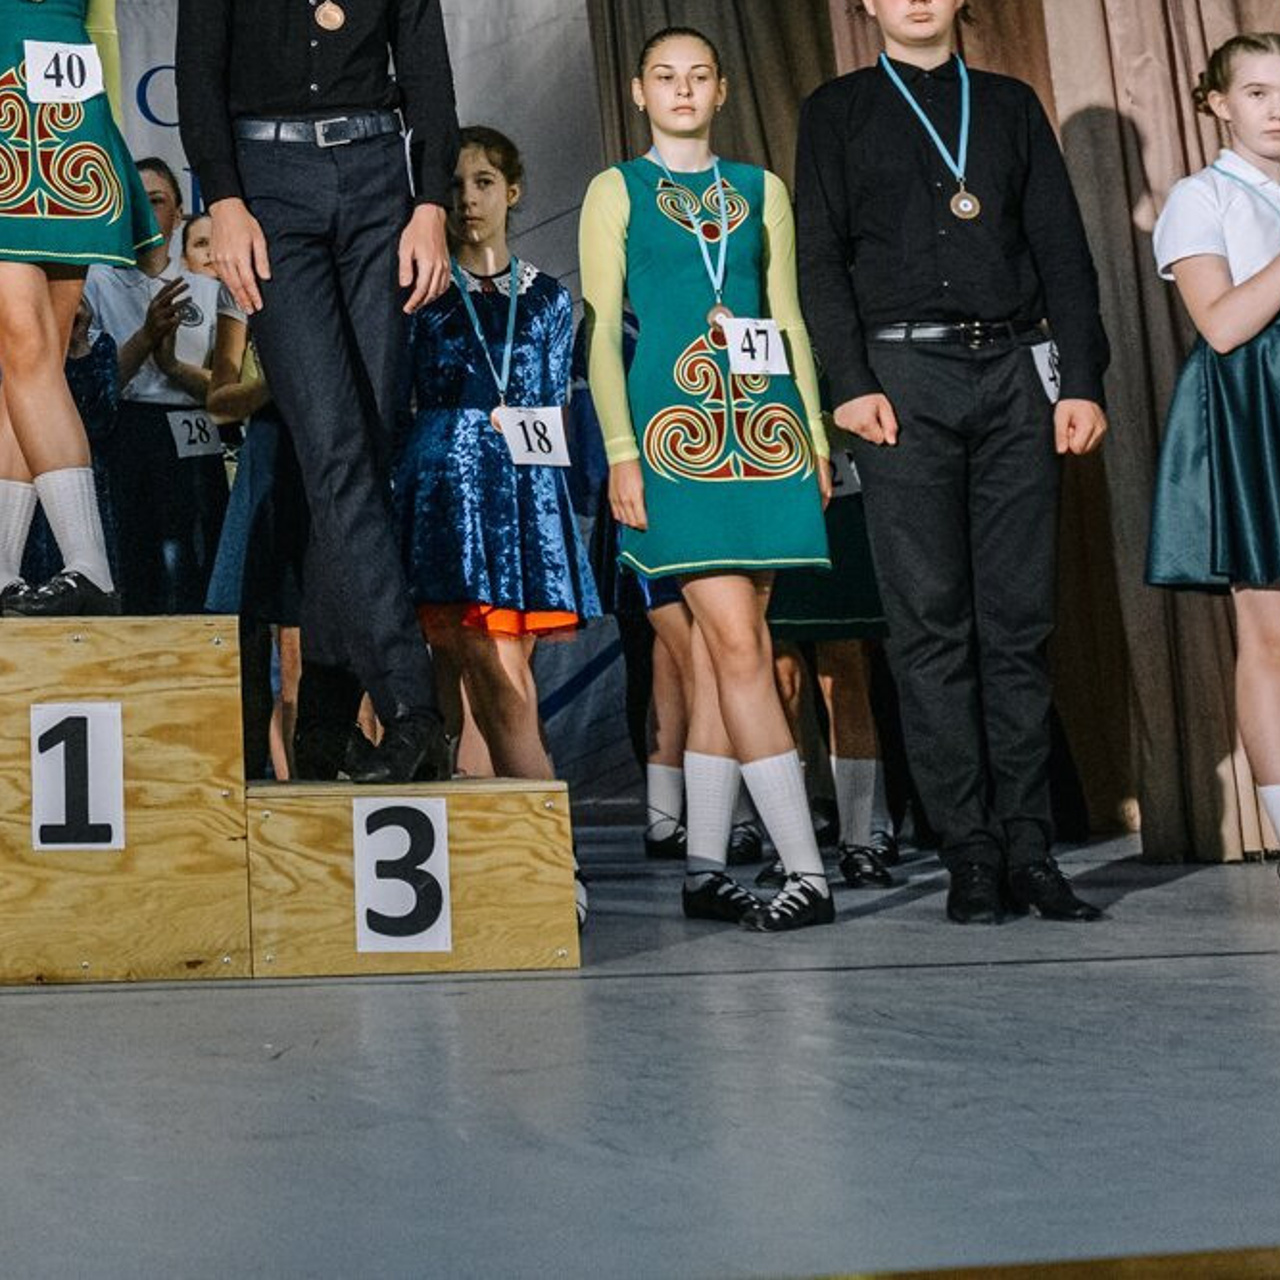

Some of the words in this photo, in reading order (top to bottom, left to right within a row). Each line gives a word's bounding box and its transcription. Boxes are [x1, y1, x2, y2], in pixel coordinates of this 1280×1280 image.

[43, 52, 86, 89] 40
[741, 328, 769, 361] 47
[182, 418, 211, 446] 28
[517, 420, 553, 455] 18
[37, 716, 113, 845] 1
[365, 805, 444, 937] 3
